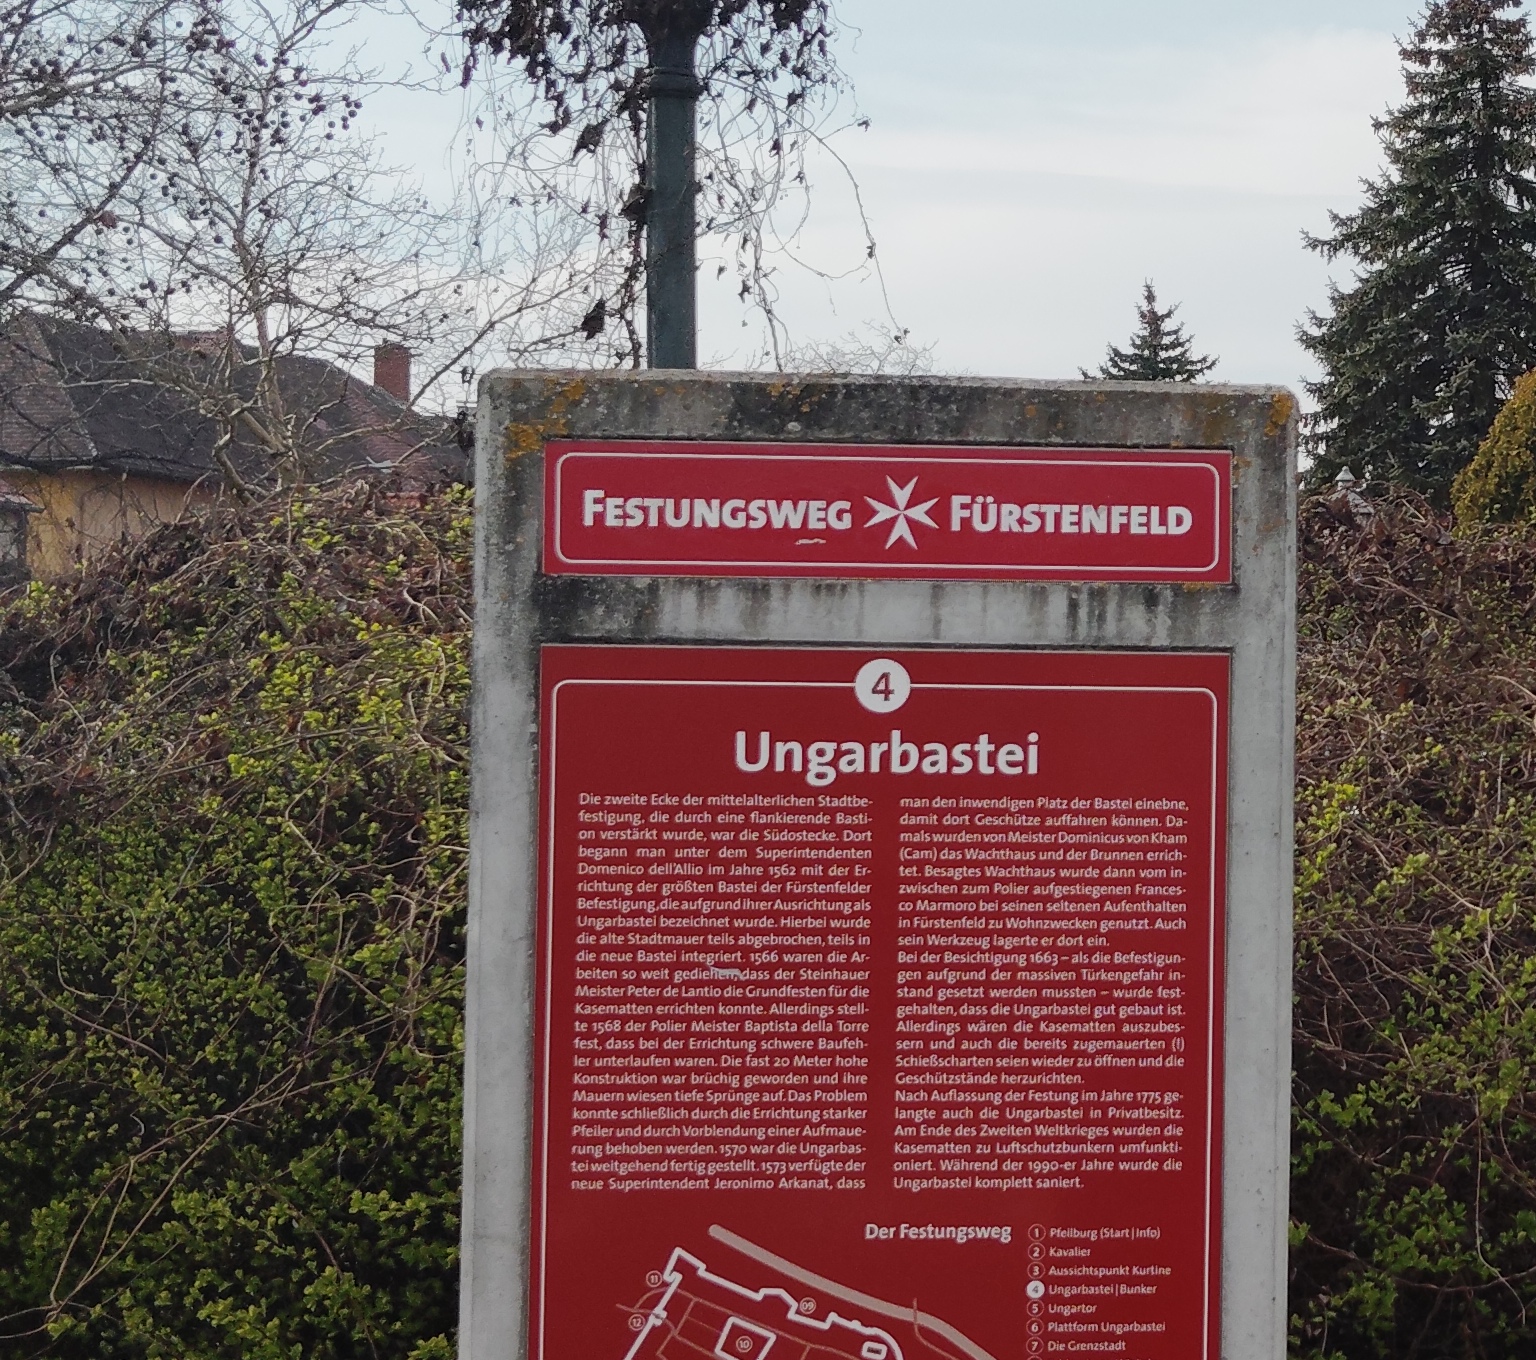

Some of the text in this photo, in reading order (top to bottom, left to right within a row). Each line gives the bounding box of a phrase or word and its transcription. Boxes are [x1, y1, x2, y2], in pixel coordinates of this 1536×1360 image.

[582, 488, 1193, 537] FESTUNGSWEG FÜRSTENFELD
[870, 672, 895, 702] 4
[735, 730, 1040, 786] Ungarbastei
[579, 793, 873, 807] Die zweite Ecke der mittelalterlichen Stadtbe-
[650, 811, 669, 822] die
[675, 811, 711, 823] durch
[717, 812, 745, 823] eine
[750, 812, 831, 824] flankierende
[836, 813, 872, 824] Basti-
[900, 813, 1187, 827] damit dort Geschütze auffahren können. Da-
[578, 828, 872, 841] on verstärkt wurde, war die Südostecke. Dort
[578, 845, 871, 861] begann man unter dem Superintendenten
[577, 880, 872, 897] richtung der größten Bastei der Fürstenfelder
[899, 882, 1186, 899] zwischen zum Polier aufgestiegenen Frances-
[576, 950, 870, 966] die neue Bastei integriert. 1566 waren die Ar-
[897, 967, 1185, 984] gen aufgrund der massiven Türkengefahr in-
[896, 1020, 1185, 1036] Allerdings wären die Kasematten auszubes-
[573, 1037, 868, 1053] fest, dass bei der Errichtung schwere Baufeh-
[573, 1072, 867, 1088] Konstruktion war brüchig geworden und ihre
[895, 1105, 1184, 1122] langte auch die Ungarbastei in Privatbesitz.
[895, 1139, 1182, 1154] Kasematten zu Luftschutzbunkern umfunkti-
[571, 1176, 865, 1192] neue Superintendent Jeronimo Arkanat, dass
[894, 1176, 1084, 1192] Ungarbastei komplett saniert.
[865, 1224, 1011, 1244] Der Festungsweg
[1050, 1228, 1098, 1241] Pfeilburg
[1050, 1247, 1090, 1257] Kavalier
[1049, 1265, 1129, 1278] Aussichtspunkt
[1133, 1266, 1171, 1275] Kurtine
[1049, 1304, 1097, 1316] Ungartor
[1048, 1322, 1098, 1332] Plattform
[1101, 1321, 1165, 1335] Ungarbastei
[1048, 1341, 1065, 1351] Die
[1068, 1340, 1126, 1351] Grenzstadt
